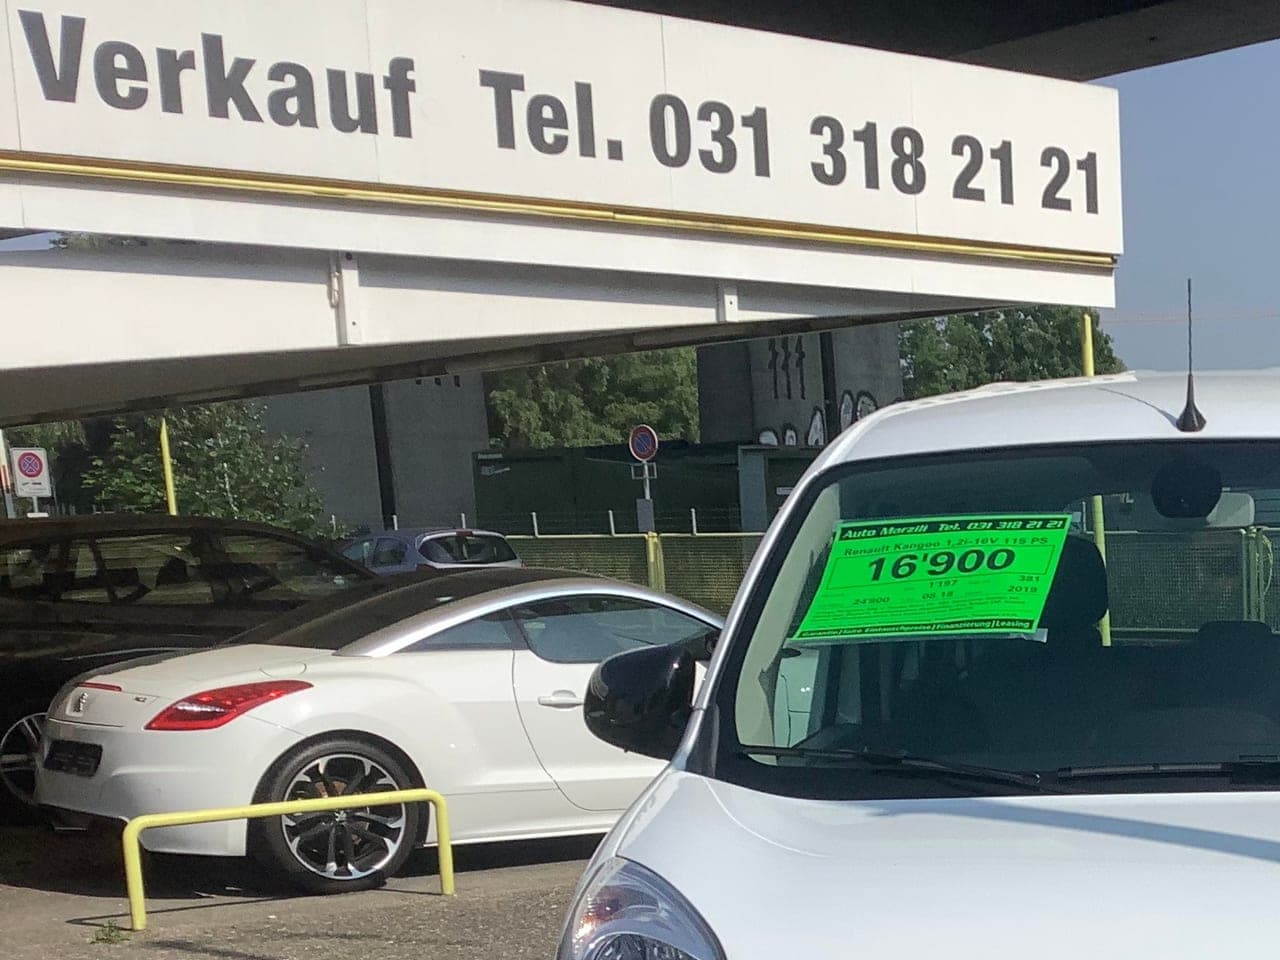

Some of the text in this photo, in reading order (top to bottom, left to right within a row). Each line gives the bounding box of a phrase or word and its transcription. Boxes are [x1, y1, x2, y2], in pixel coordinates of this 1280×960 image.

[18, 9, 1099, 214] Verkauf Tel. 031 318 21 21
[842, 528, 877, 539] Auto
[879, 523, 929, 536] Marzili
[966, 521, 993, 530] 031
[996, 520, 1023, 530] 318
[1025, 520, 1043, 529] 21
[1046, 520, 1064, 529] 21
[868, 548, 1016, 582] 16'900
